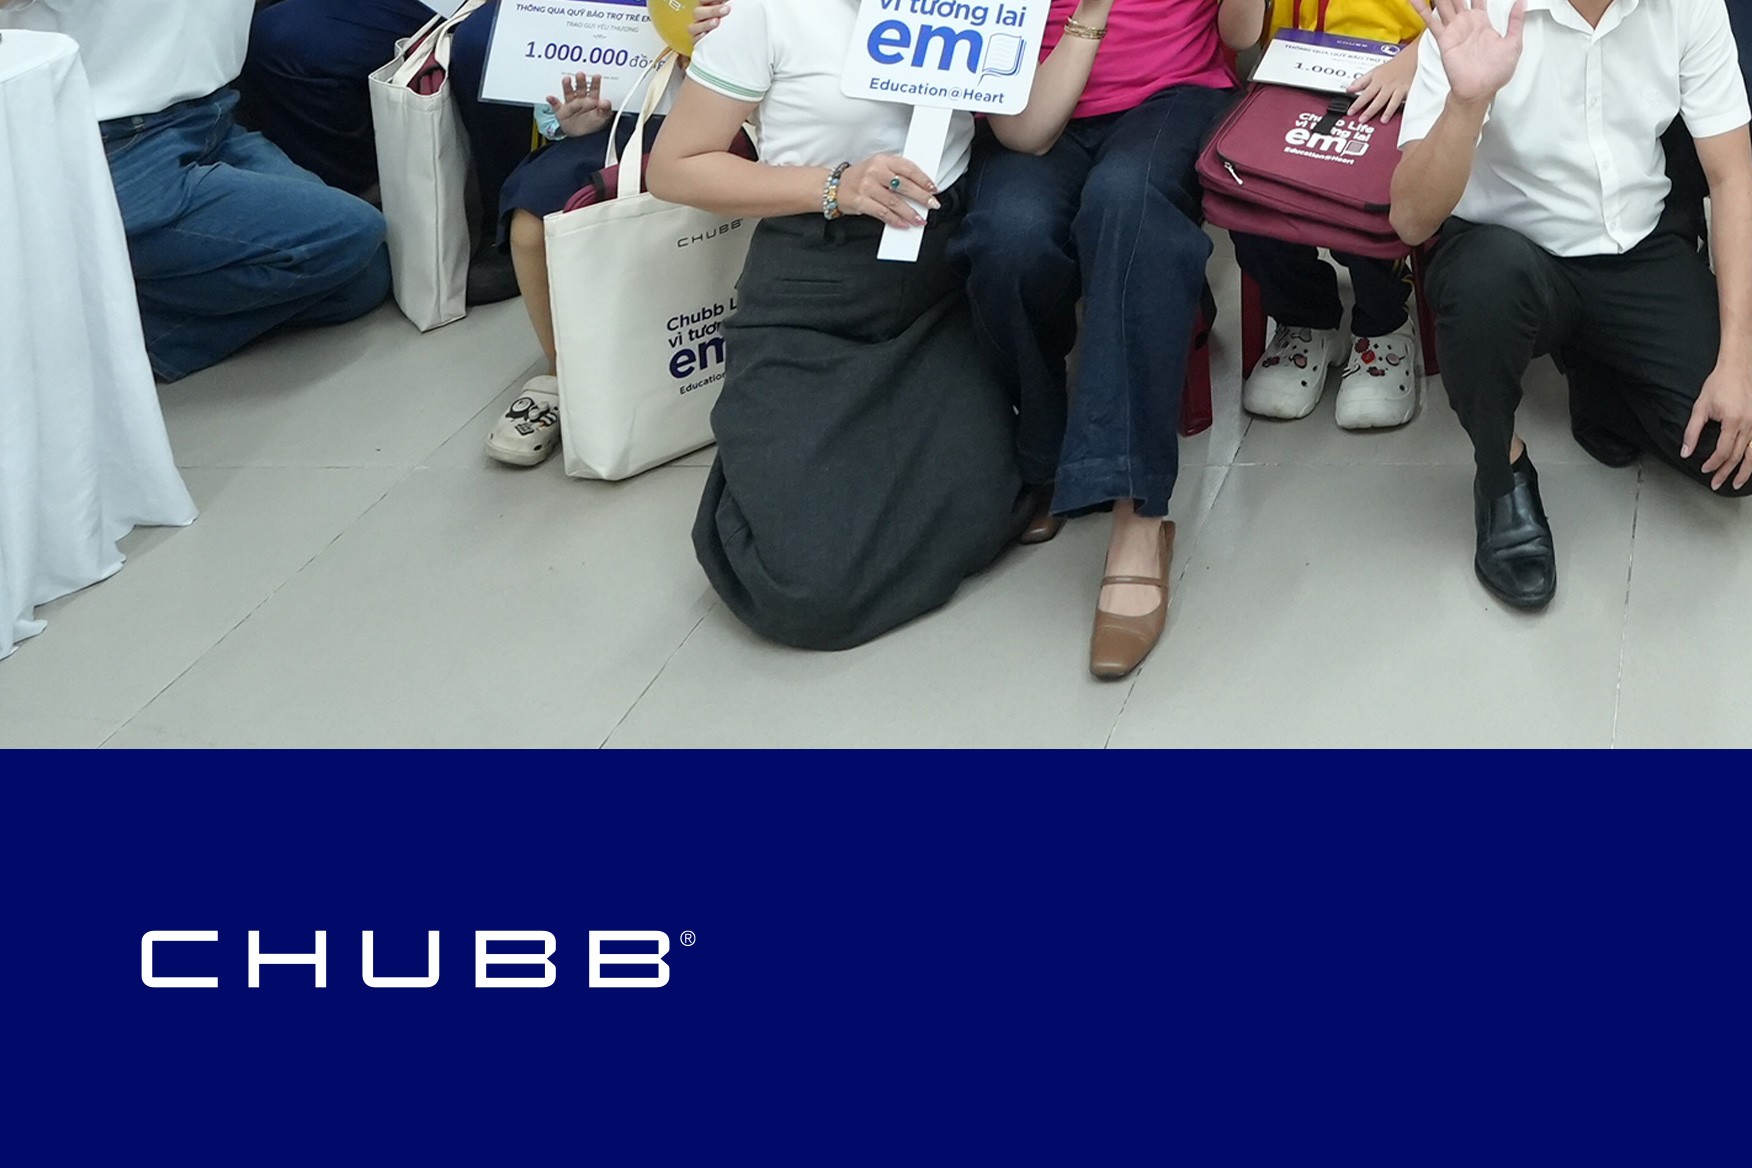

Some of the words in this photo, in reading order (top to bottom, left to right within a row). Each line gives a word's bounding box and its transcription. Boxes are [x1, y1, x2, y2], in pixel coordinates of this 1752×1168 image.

[516, 4, 545, 13] THÔNG
[547, 7, 565, 15] QUA
[567, 8, 586, 17] QUỸ
[586, 11, 604, 19] BẢO
[606, 12, 624, 20] TRỢ
[625, 13, 640, 22] TRẺ
[995, 4, 1027, 27] lai
[525, 41, 628, 66] 1.000.000
[867, 19, 983, 74] em
[1294, 62, 1364, 79] 1.000.0
[869, 77, 1005, 104] Education@Heart
[1348, 121, 1374, 134] Life
[1285, 128, 1348, 154] em
[677, 219, 742, 248] CHUBB
[667, 303, 724, 331] Chubb
[668, 332, 683, 348] vì
[688, 321, 721, 341] tươ
